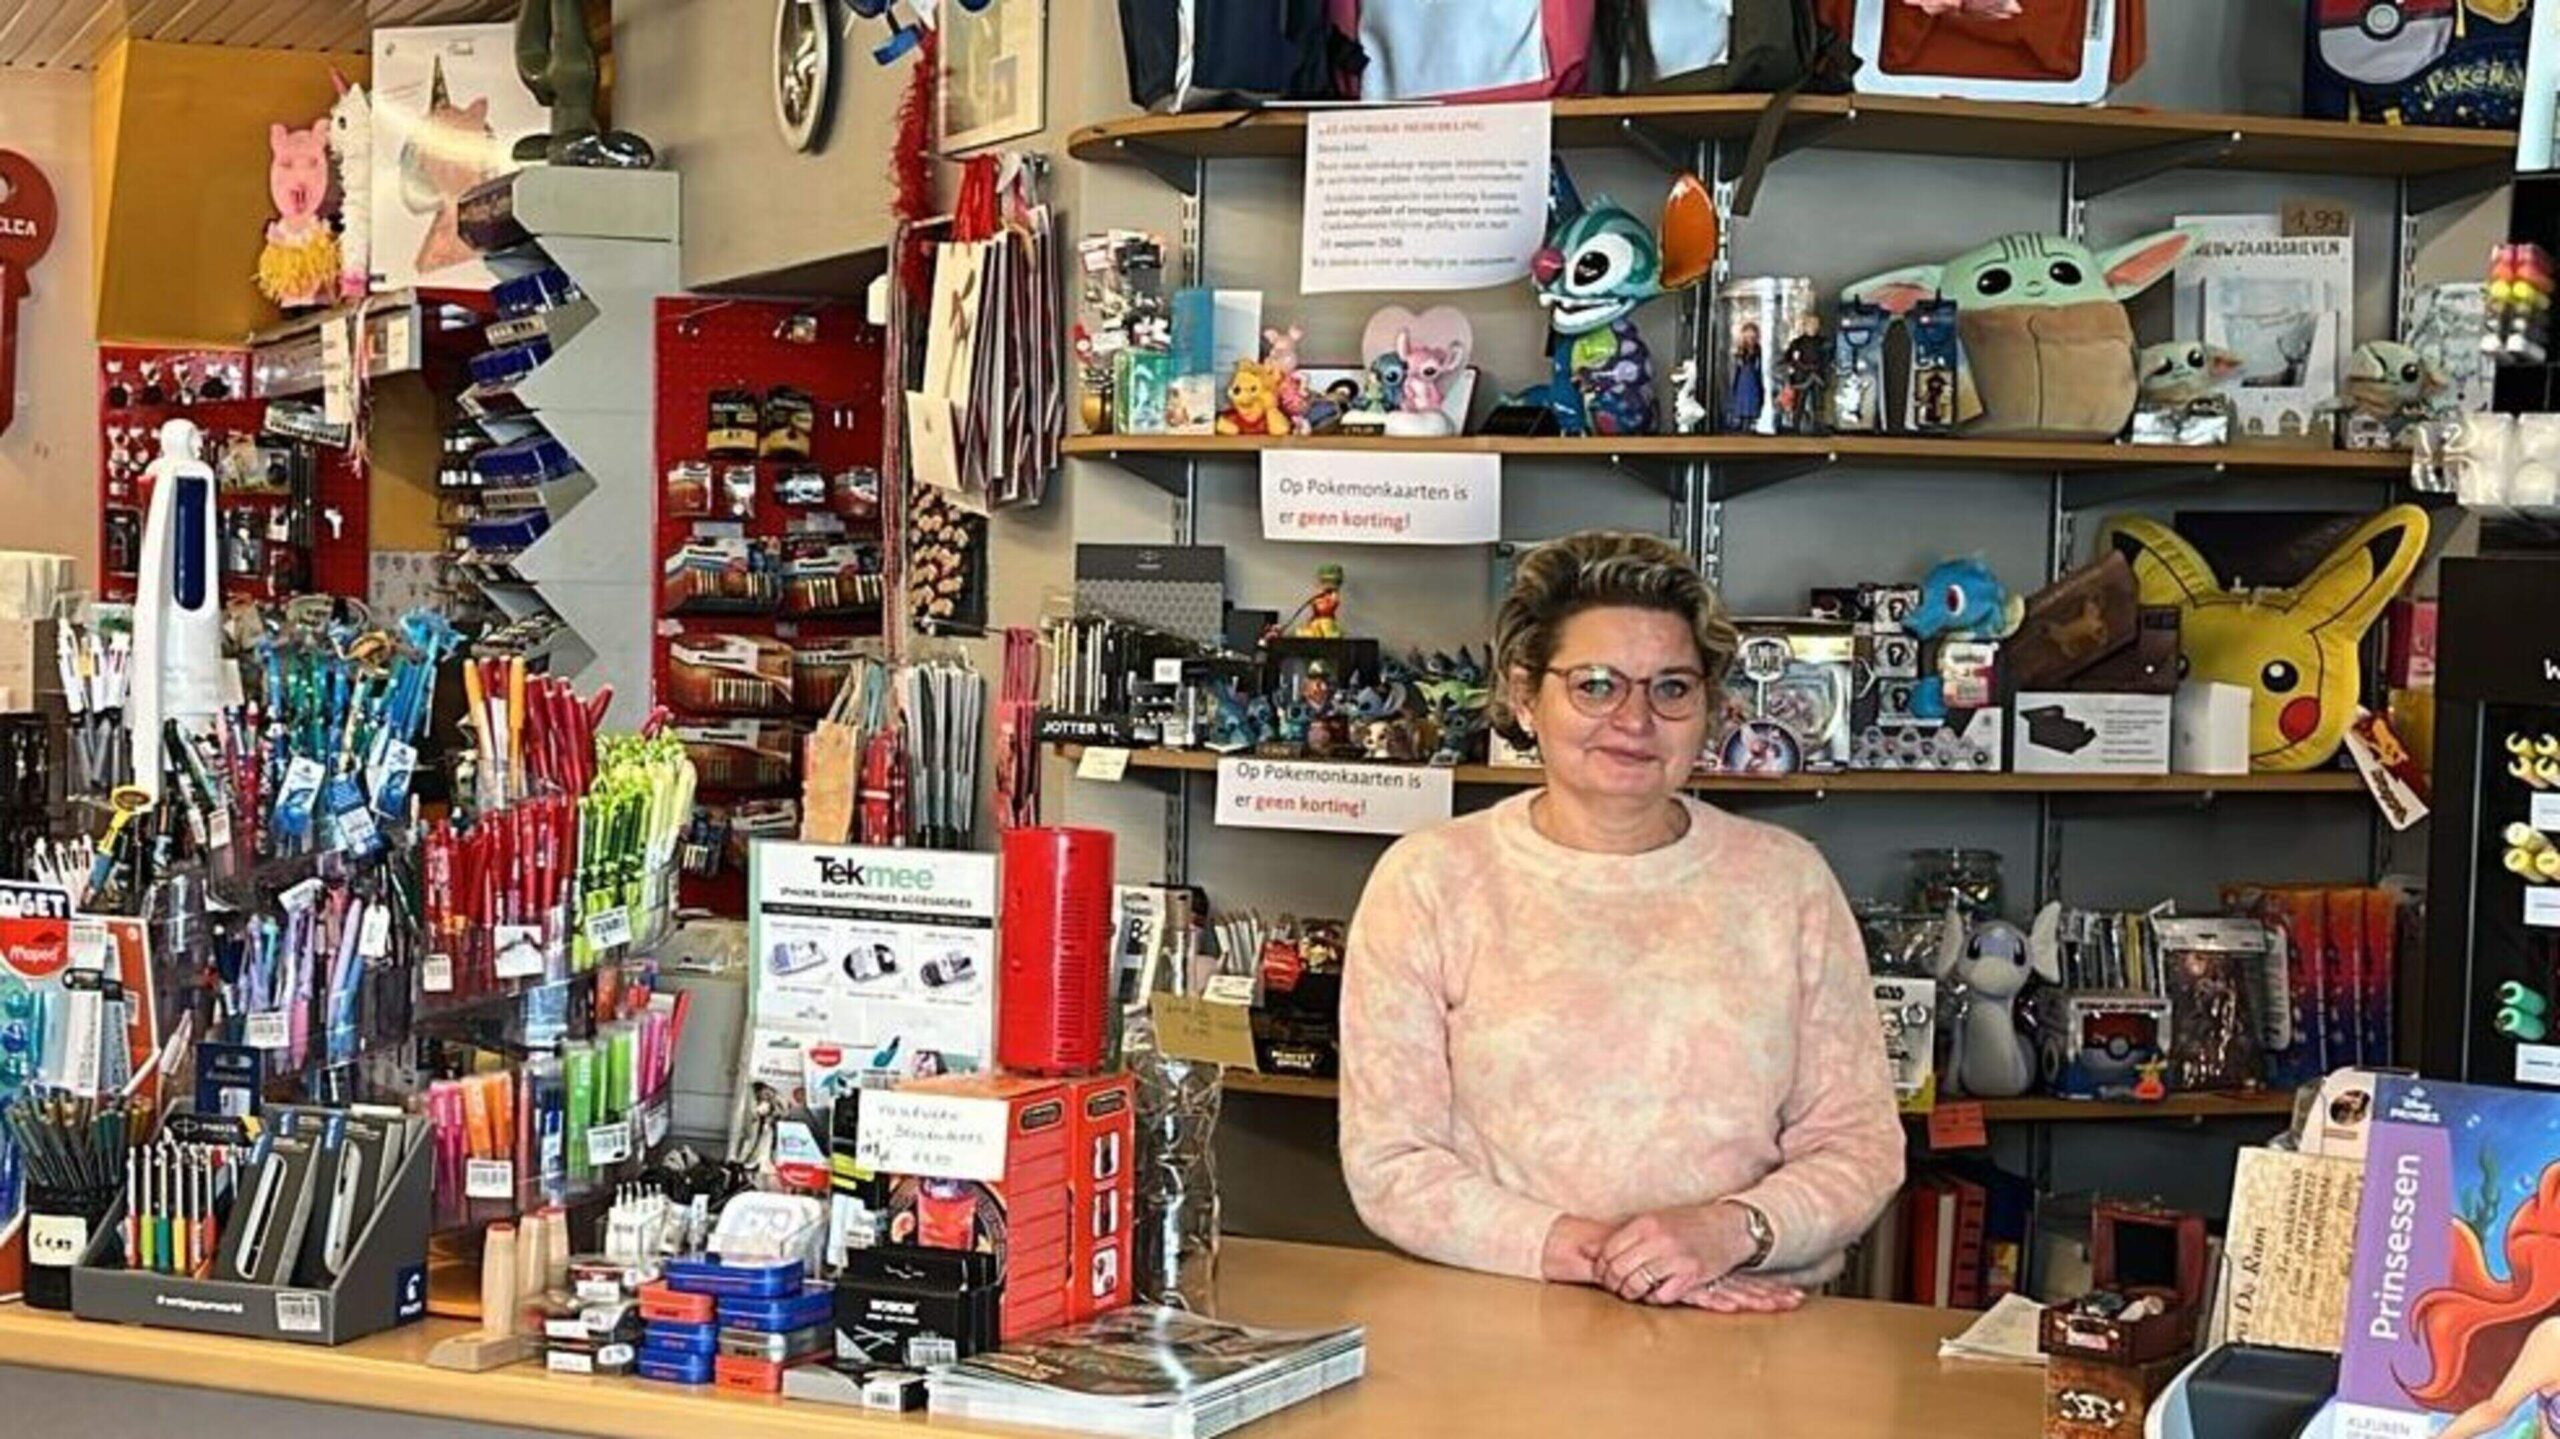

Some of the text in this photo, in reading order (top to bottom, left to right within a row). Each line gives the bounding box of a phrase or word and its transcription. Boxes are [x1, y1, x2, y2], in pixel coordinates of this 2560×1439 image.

[1279, 477, 1469, 501] Op Pokemonkaarten is
[1279, 510, 1411, 533] er geen korting!
[1042, 720, 1097, 735] JOTTER
[1236, 761, 1422, 789] Op Pokemonkaarten is
[1235, 793, 1367, 818] er geen korting!
[814, 855, 934, 891] Tekmee
[2369, 1153, 2422, 1341] Prinsessen
